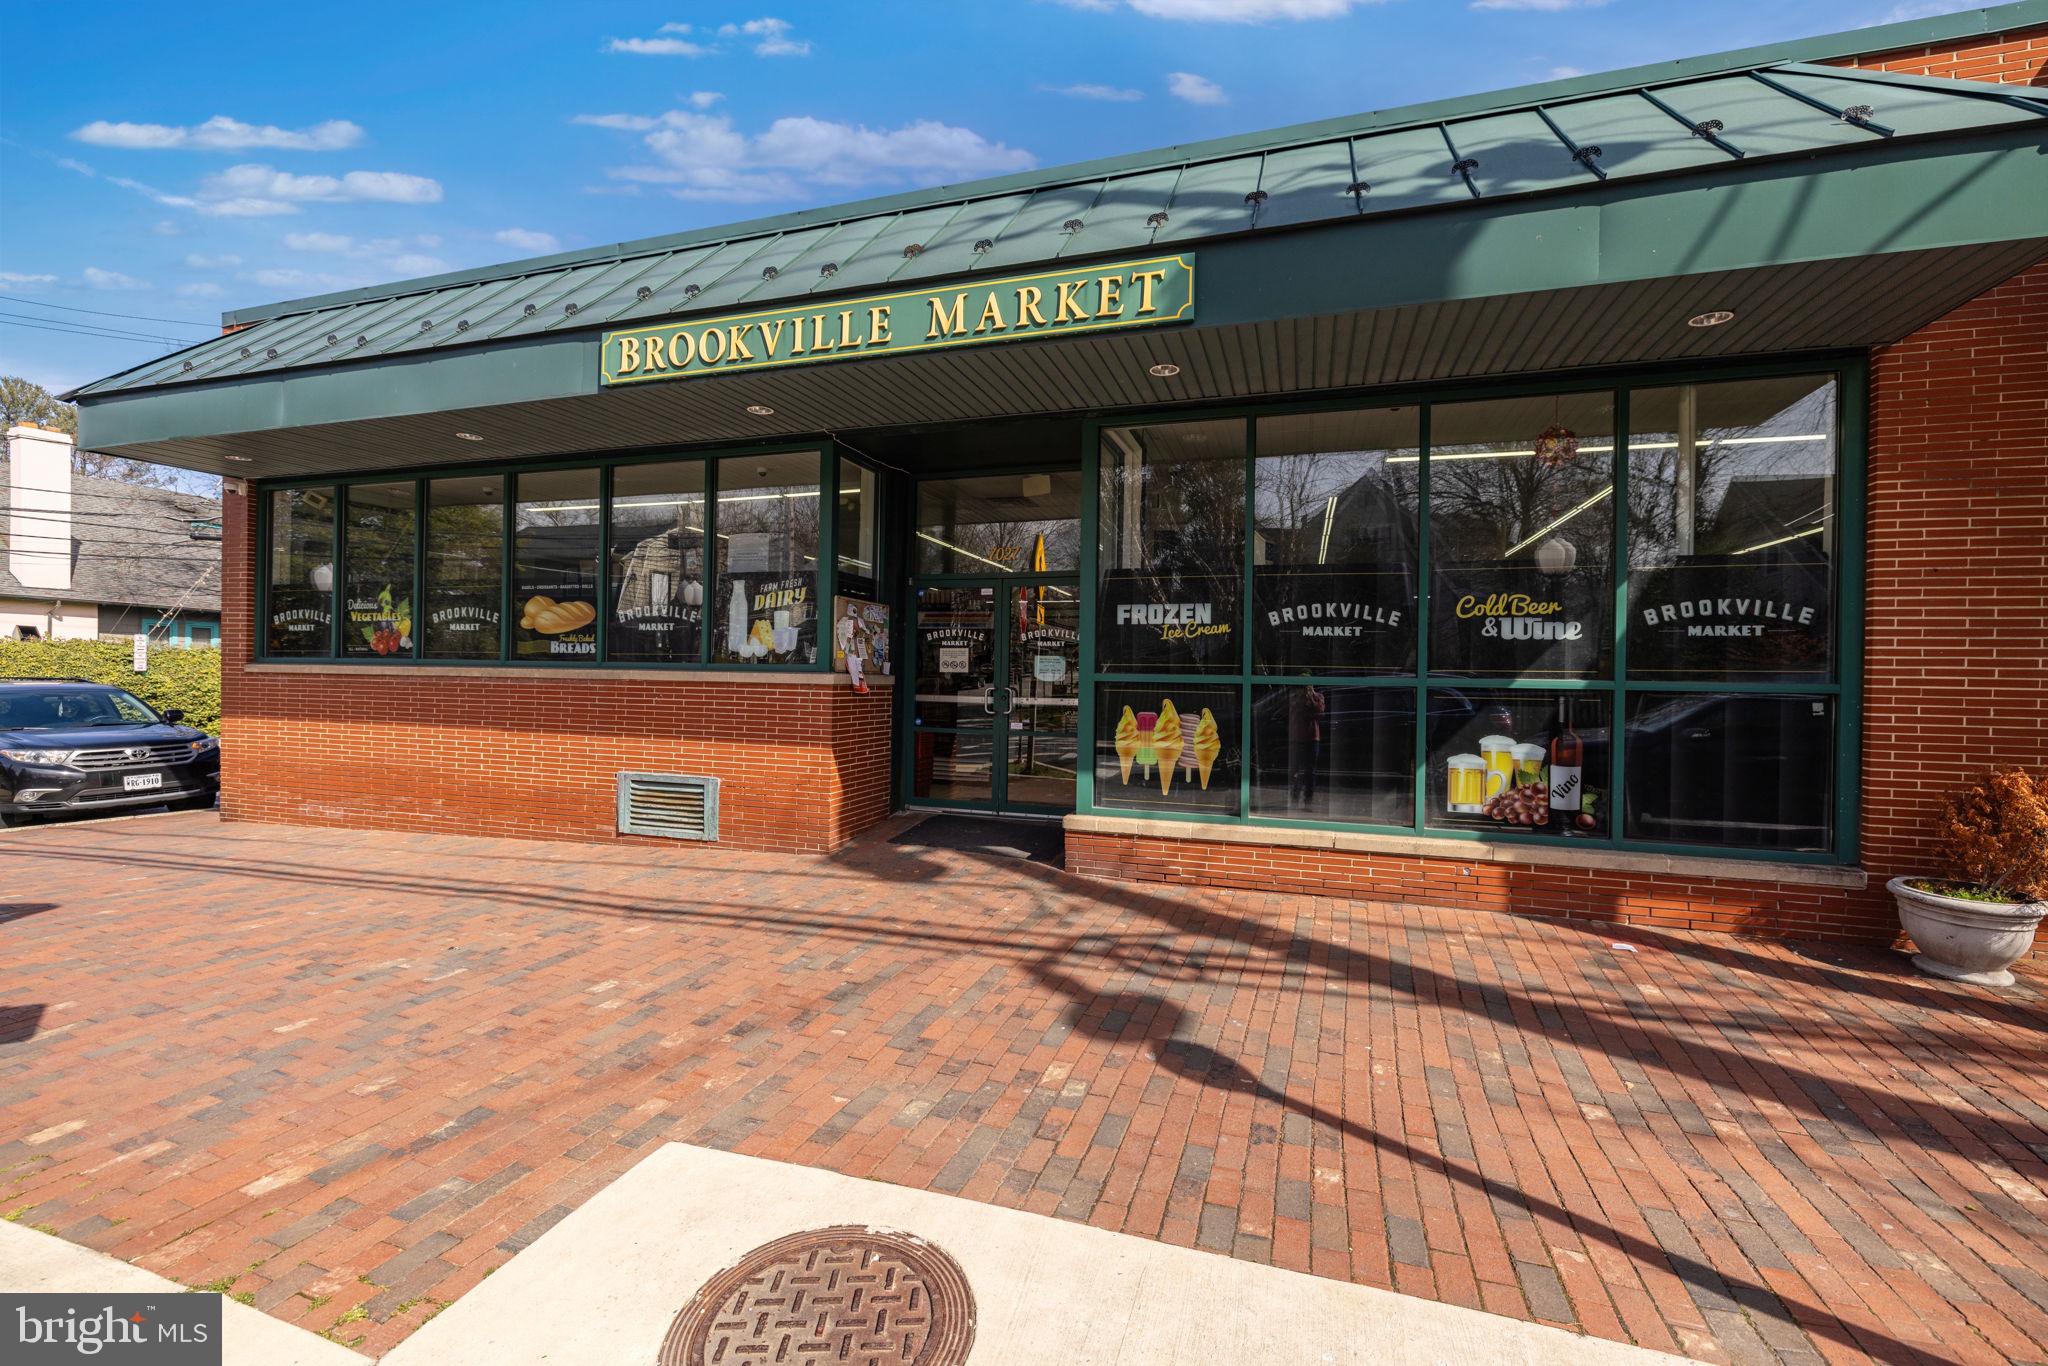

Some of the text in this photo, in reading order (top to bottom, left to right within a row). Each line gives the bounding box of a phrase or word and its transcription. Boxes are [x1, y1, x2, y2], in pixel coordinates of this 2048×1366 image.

[617, 268, 1166, 374] BROOKVILLE MARKET
[760, 577, 802, 593] FARM FRESH
[347, 599, 378, 610] Delicious
[754, 587, 807, 610] DAIRY
[1456, 593, 1562, 619] Cold Beer
[274, 609, 332, 625] BROOKVILLE
[432, 607, 499, 624] BROOKVILLE
[618, 605, 696, 624] BROOKVILLE
[1117, 603, 1211, 625] FROZEN
[1268, 602, 1401, 627] BROOKVILLE
[1643, 598, 1816, 625] BROOKVILLE
[288, 624, 315, 632] MARKET
[449, 623, 480, 631] MARKET
[638, 622, 675, 631] MARKET
[926, 629, 985, 641] BROOKVILLE
[1161, 620, 1231, 640] Ice Cream
[1302, 626, 1362, 637] MARKET
[1481, 617, 1582, 640] & Wine
[1688, 625, 1765, 637] MARKET
[550, 640, 596, 654] BREADS
[1551, 774, 1579, 799] Vino
